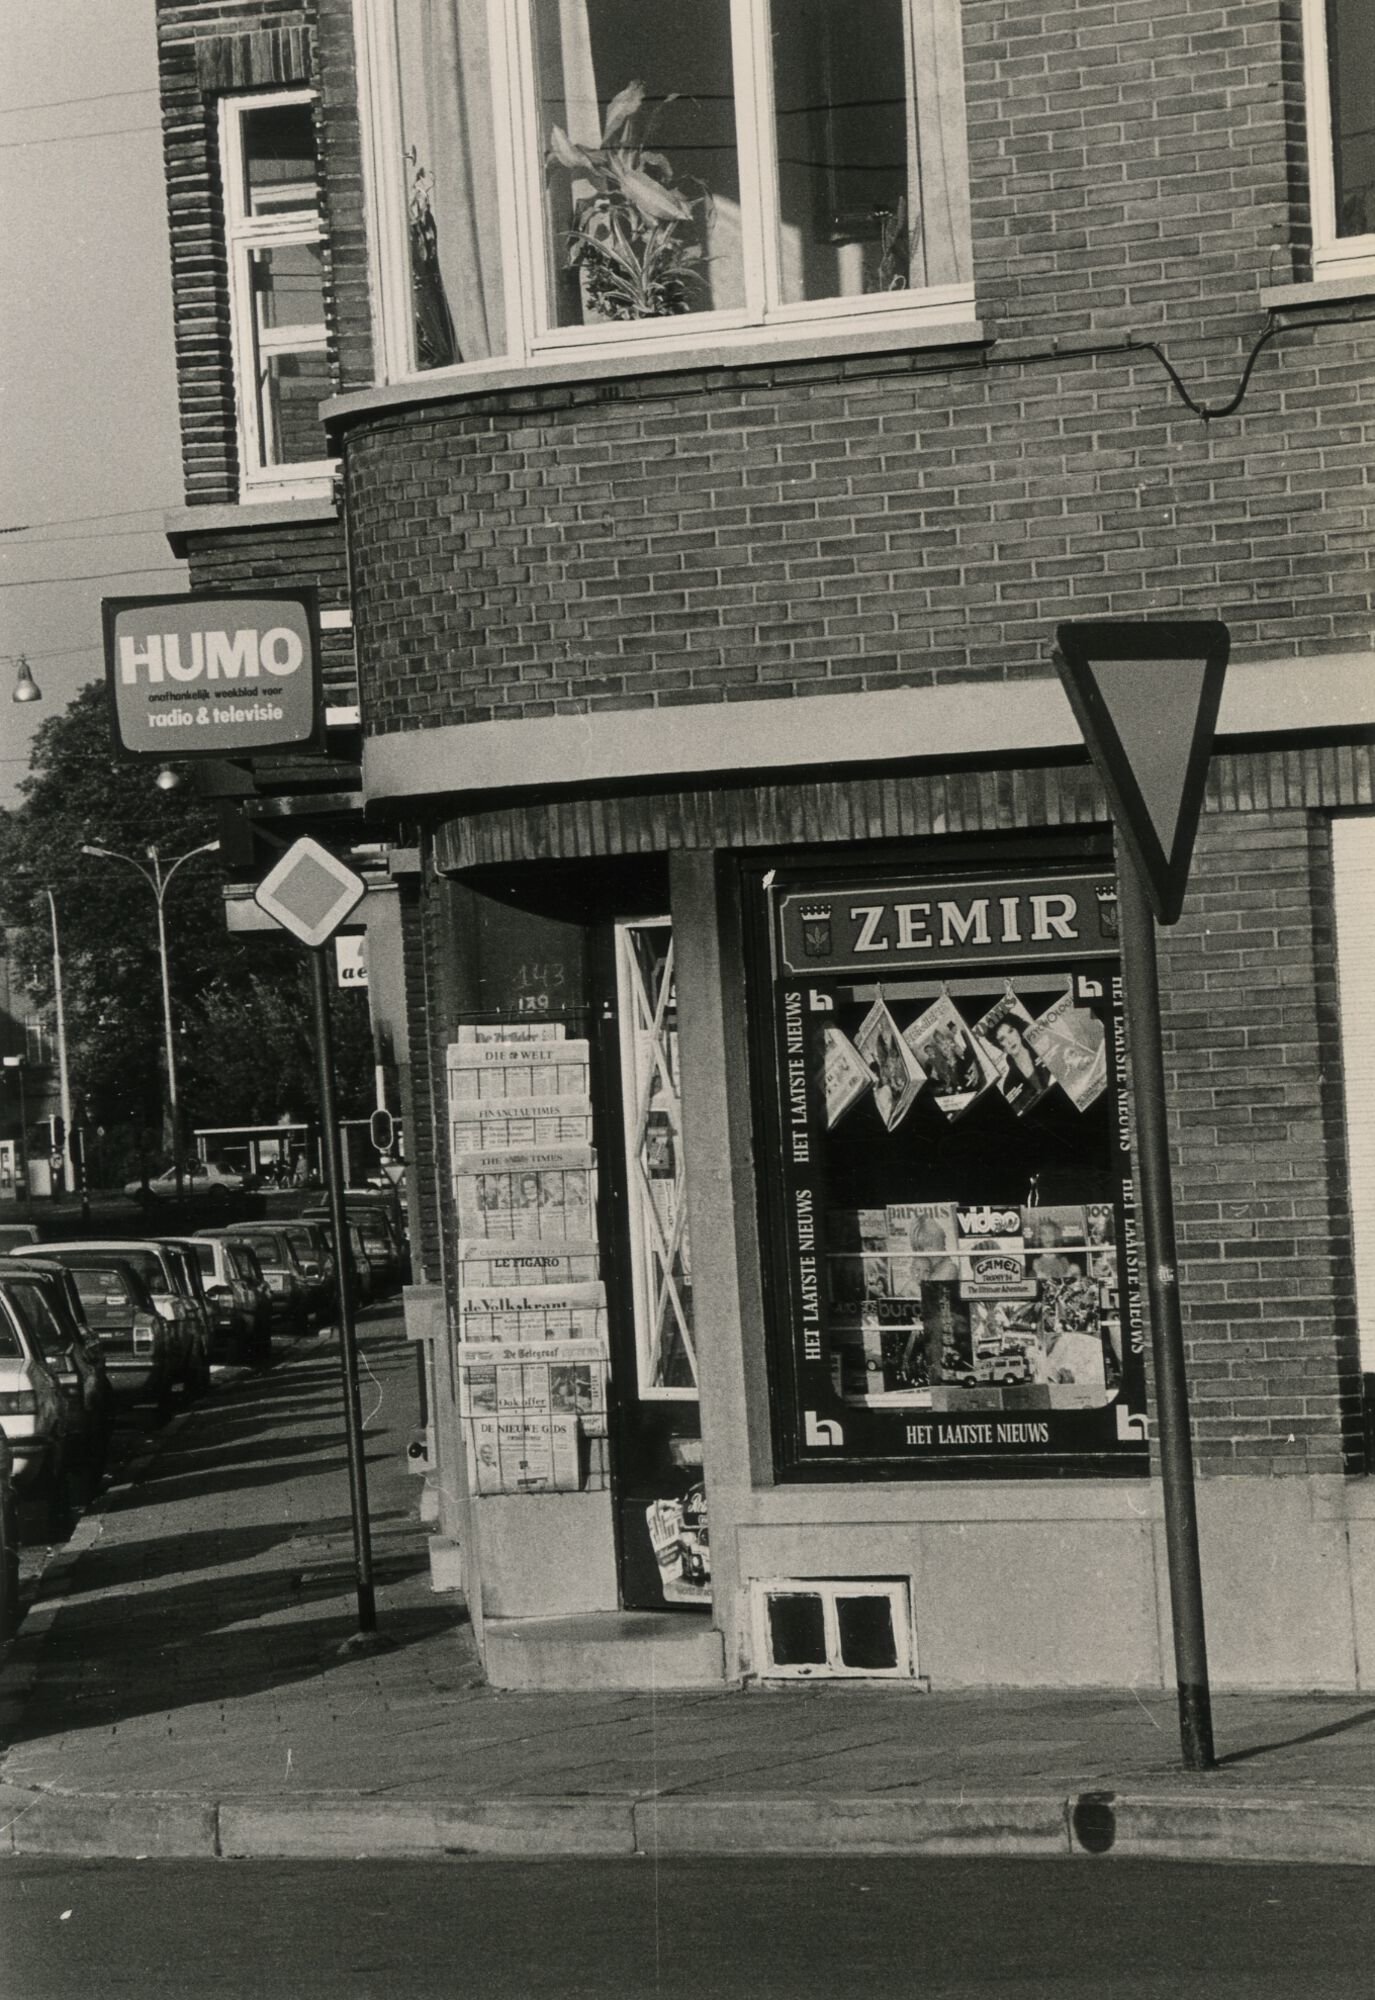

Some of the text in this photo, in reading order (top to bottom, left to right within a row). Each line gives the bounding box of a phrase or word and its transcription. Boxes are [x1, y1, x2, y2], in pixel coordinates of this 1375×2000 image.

[119, 627, 303, 685] HUMO
[214, 686, 259, 699] weekblad
[262, 686, 284, 697] voor
[148, 703, 284, 727] radio & televisie
[850, 893, 1079, 952] ZEMIR
[484, 1050, 553, 1061] DIE WELT
[784, 992, 809, 1163] HET LAATSTE NIEUWS
[478, 1106, 562, 1118] FINANCIAL TIMES
[480, 1154, 563, 1166] THE TIMES
[887, 1205, 950, 1223] parents
[956, 1206, 1021, 1234] video
[494, 1257, 560, 1268] LE FIGARO
[976, 1259, 1019, 1275] CAMEL
[795, 1189, 821, 1360] HET LAATSTE NIEUWS
[463, 1298, 567, 1313] de Volkskrant
[503, 1349, 516, 1359] De
[517, 1347, 559, 1360] Telegraaf
[481, 1423, 495, 1433] DE
[497, 1423, 539, 1434] NIEUWE
[906, 1422, 1050, 1445] HET LAATSTE NIEUWS
